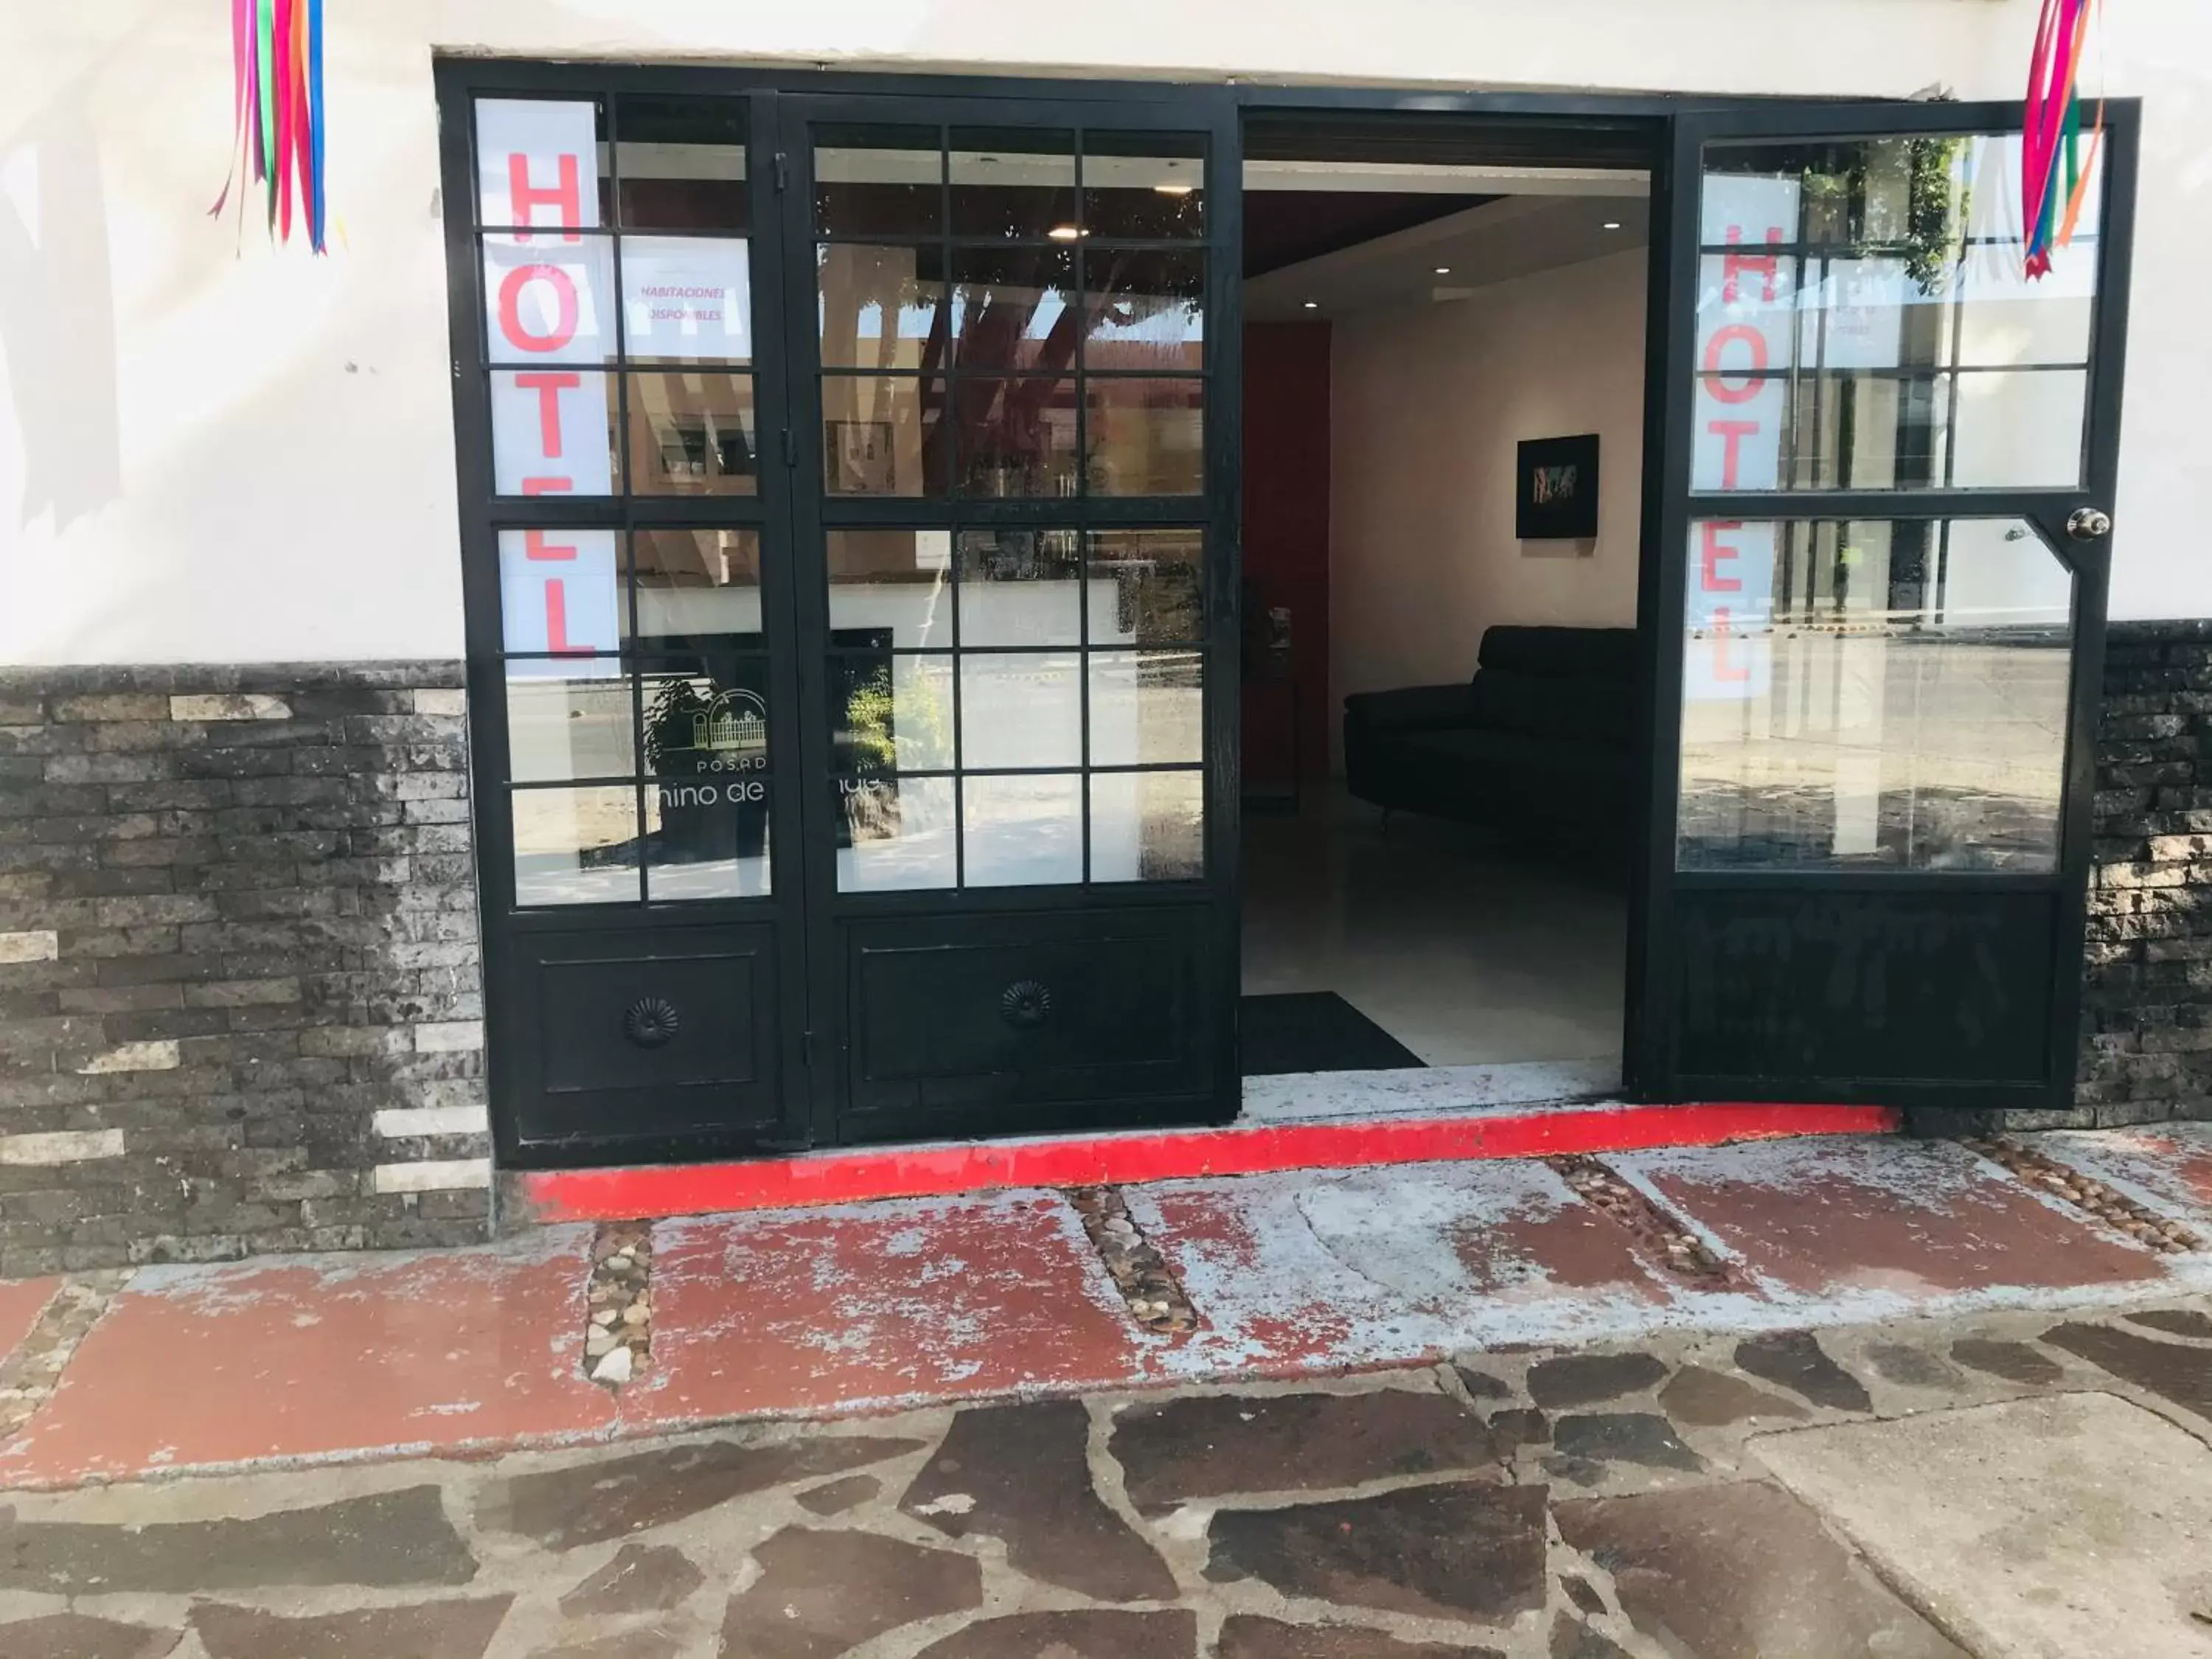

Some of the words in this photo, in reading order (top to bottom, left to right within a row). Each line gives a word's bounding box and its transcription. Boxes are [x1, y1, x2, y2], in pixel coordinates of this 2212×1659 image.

[498, 153, 596, 661] HOTEL
[649, 307, 723, 321] DISPOBLES
[1700, 224, 1782, 682] HOTEL
